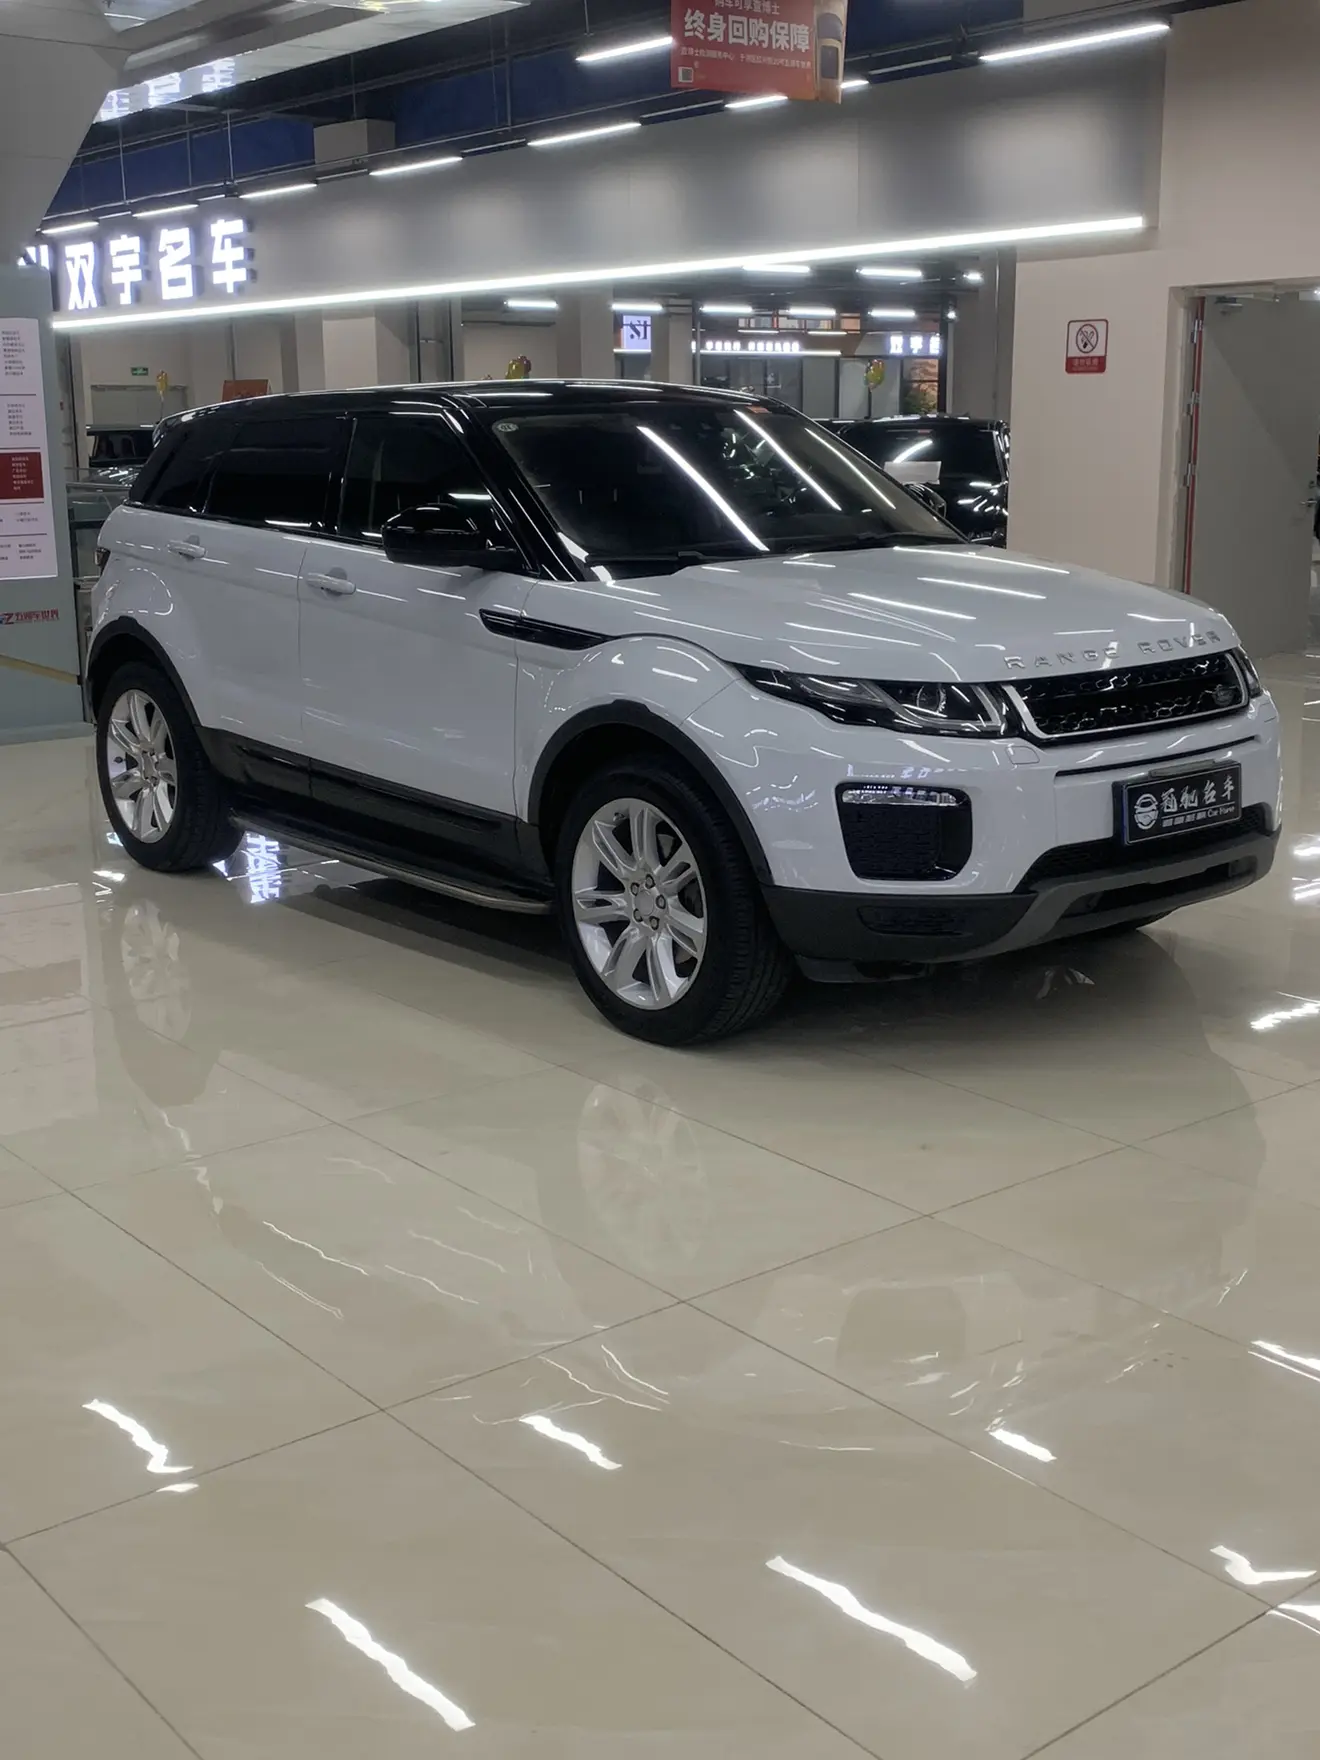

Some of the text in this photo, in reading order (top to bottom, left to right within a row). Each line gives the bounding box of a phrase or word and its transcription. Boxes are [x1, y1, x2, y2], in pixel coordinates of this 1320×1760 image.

[684, 8, 810, 53] 终身回购保障
[1003, 630, 1222, 670] RANGE ROVER
